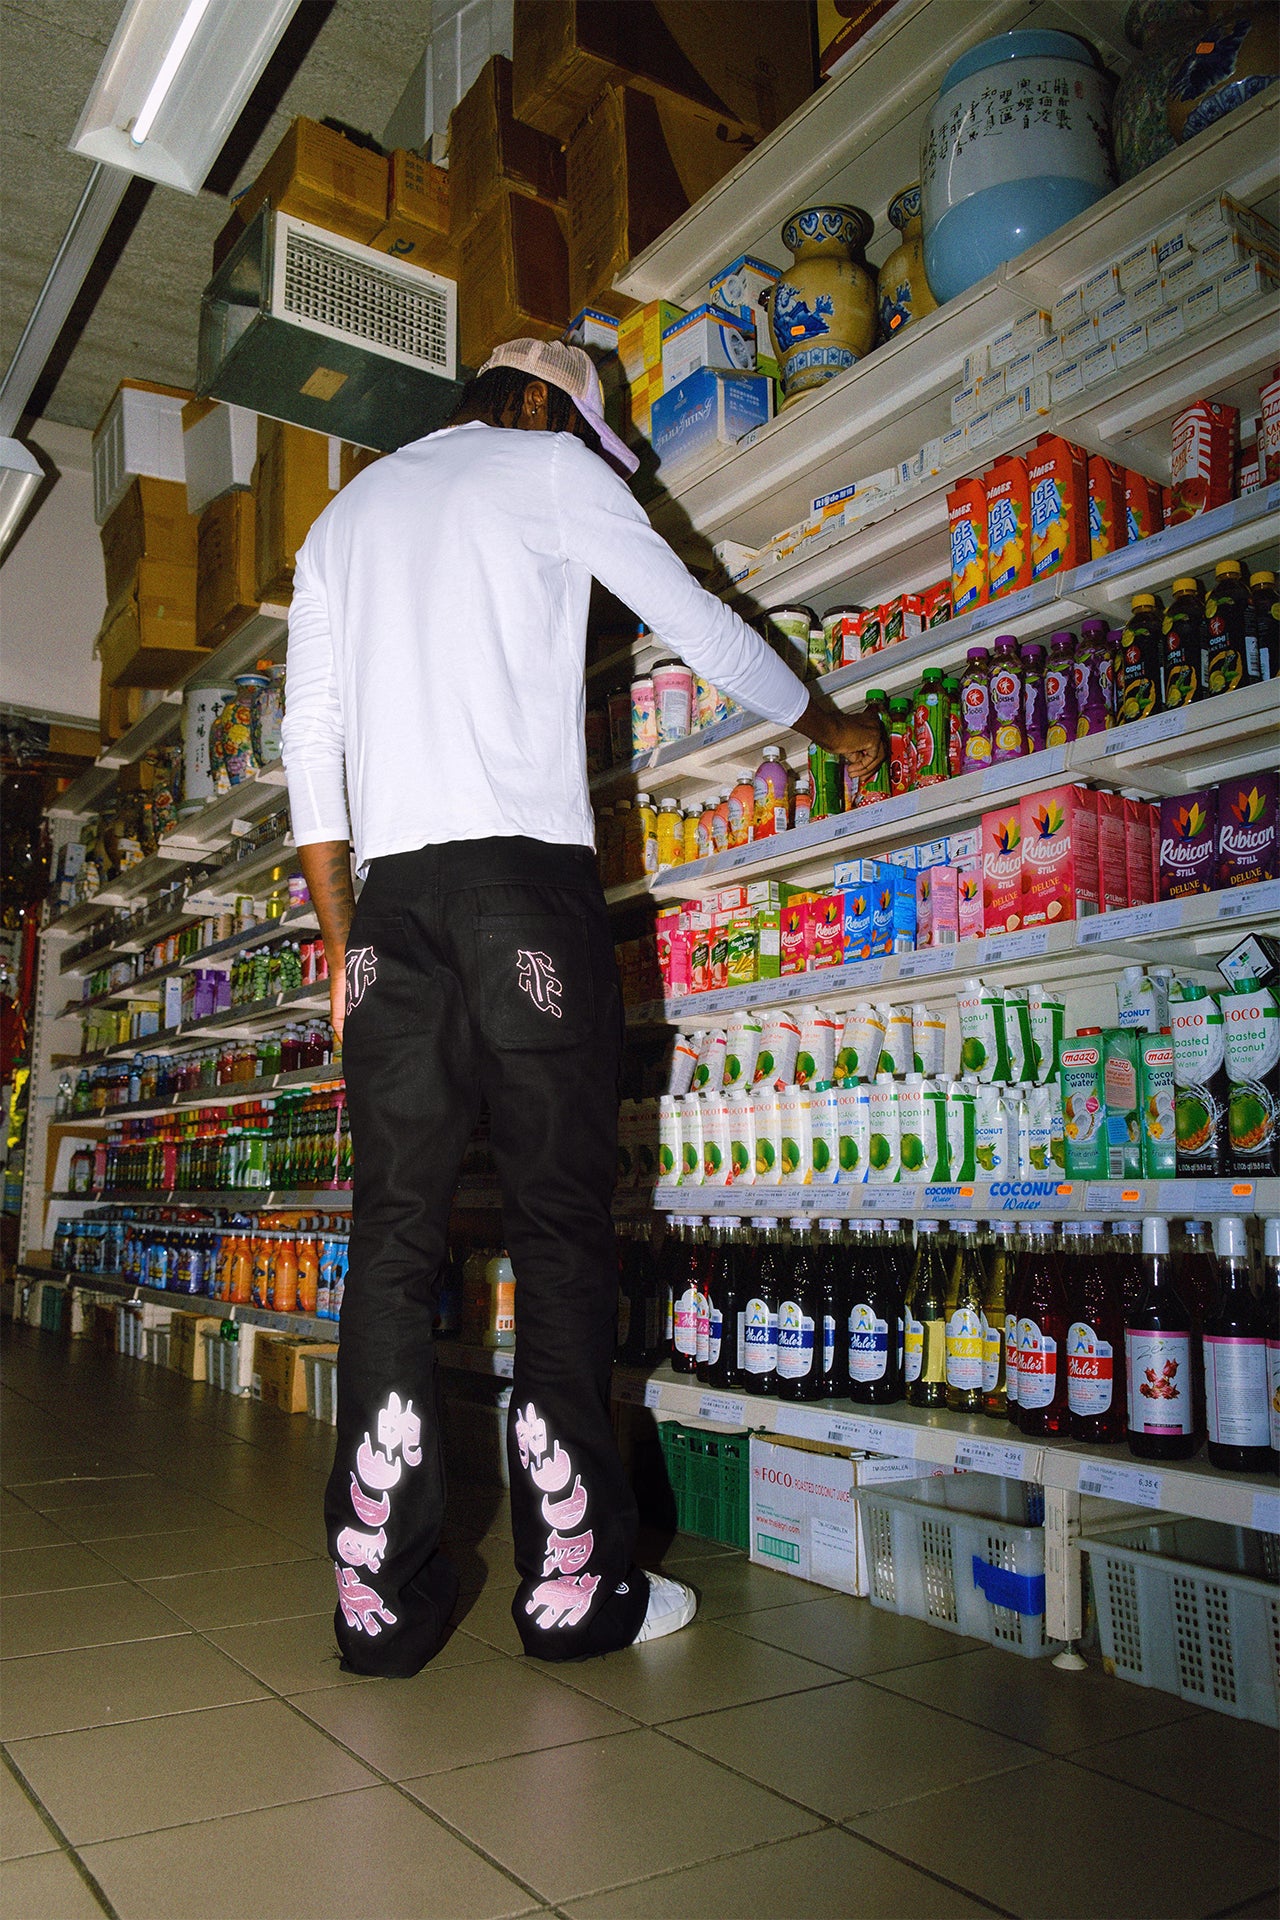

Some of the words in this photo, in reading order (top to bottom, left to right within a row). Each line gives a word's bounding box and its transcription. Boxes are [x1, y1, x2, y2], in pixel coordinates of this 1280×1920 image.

[1219, 824, 1275, 854] Rubicon
[1022, 836, 1071, 864] Rubicon
[1160, 838, 1213, 867] Rubicon
[984, 853, 1021, 879] Rubico
[1237, 855, 1258, 865] STILL
[1037, 866, 1057, 875] STILL
[1176, 868, 1196, 877] STILL
[1230, 866, 1262, 885] DELUXE
[998, 880, 1015, 889] STILL
[1031, 876, 1060, 894] DELUXE
[1169, 879, 1200, 897] DELUXE
[992, 891, 1018, 908] DELUXE
[815, 922, 840, 939] Rubicon
[960, 1012, 989, 1023] oconut
[1119, 1008, 1151, 1019] OCONUT
[1224, 1007, 1260, 1022] FOCO
[1174, 1034, 1209, 1048] oasted
[1064, 1052, 1096, 1064] maaza
[1174, 1049, 1208, 1059] oconut
[1065, 1072, 1098, 1081] Coconut
[1070, 1079, 1094, 1087] water
[1154, 1079, 1175, 1087] wate
[925, 1187, 961, 1195] COCONUT
[990, 1181, 1064, 1197] COCONUT
[1002, 1197, 1041, 1210] Water
[779, 1330, 803, 1346] Hale's
[850, 1333, 877, 1349] Hale's
[1017, 1353, 1042, 1371] Hale's
[1069, 1357, 1099, 1376] Hale's
[1016, 1454, 1022, 1462] €
[1153, 1480, 1159, 1489] €
